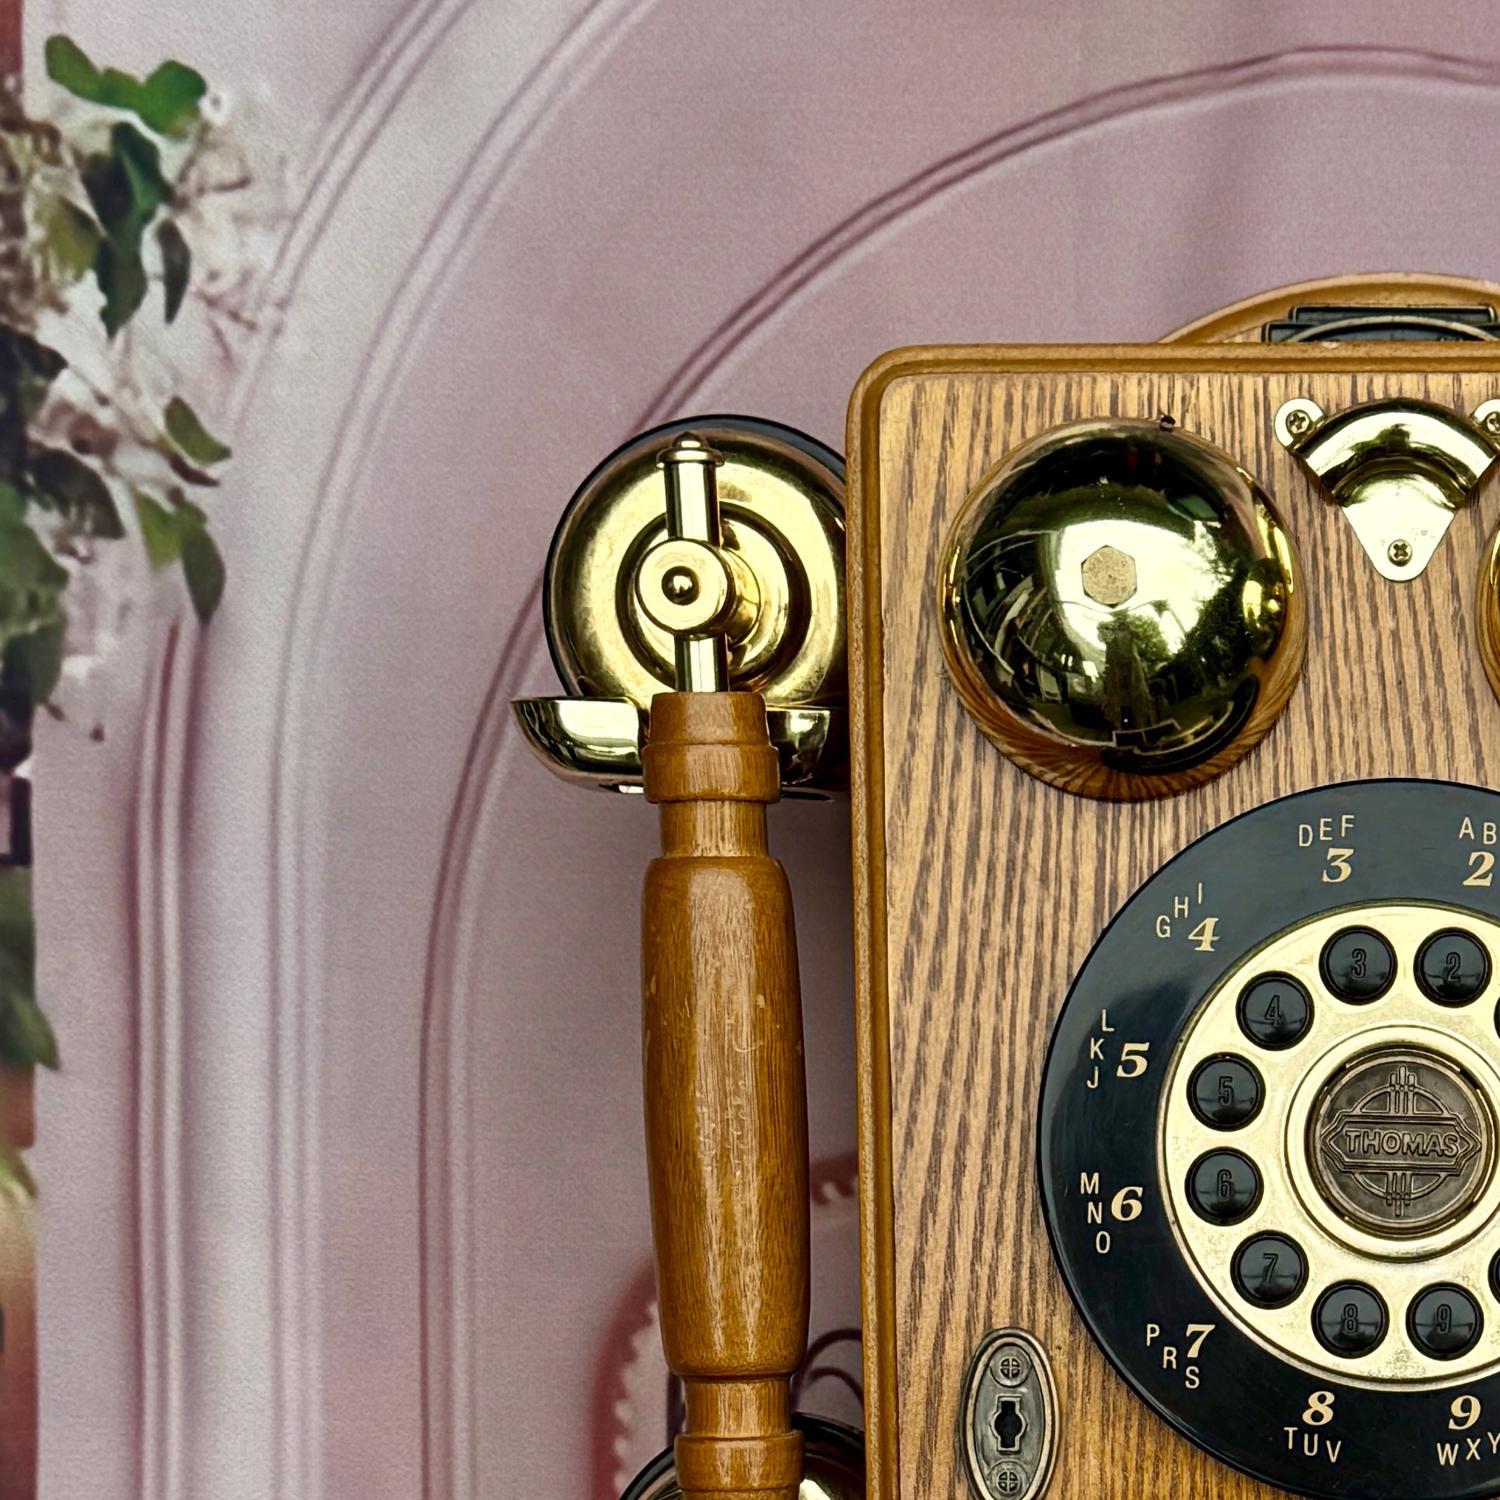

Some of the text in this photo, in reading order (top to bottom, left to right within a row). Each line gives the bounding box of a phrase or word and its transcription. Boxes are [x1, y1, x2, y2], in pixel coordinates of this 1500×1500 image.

[1298, 814, 1355, 847] DEF
[1321, 847, 1354, 883] 3
[1462, 851, 1495, 887] 2
[1187, 917, 1220, 952] 4
[1351, 948, 1367, 979] 3
[1446, 952, 1461, 983] 2
[1264, 994, 1282, 1027] 4
[1116, 1042, 1150, 1078] 5
[1218, 1076, 1234, 1106] 5
[1344, 1128, 1461, 1158] THOMAS
[1216, 1168, 1232, 1200] 6
[1111, 1186, 1143, 1221] 6
[1263, 1252, 1279, 1284] 7
[1343, 1303, 1358, 1335] 8
[1436, 1303, 1452, 1334] 9
[1185, 1323, 1216, 1358] 7
[1302, 1390, 1335, 1426] 8
[1448, 1395, 1481, 1430] 9
[1283, 1426, 1342, 1463] TUV
